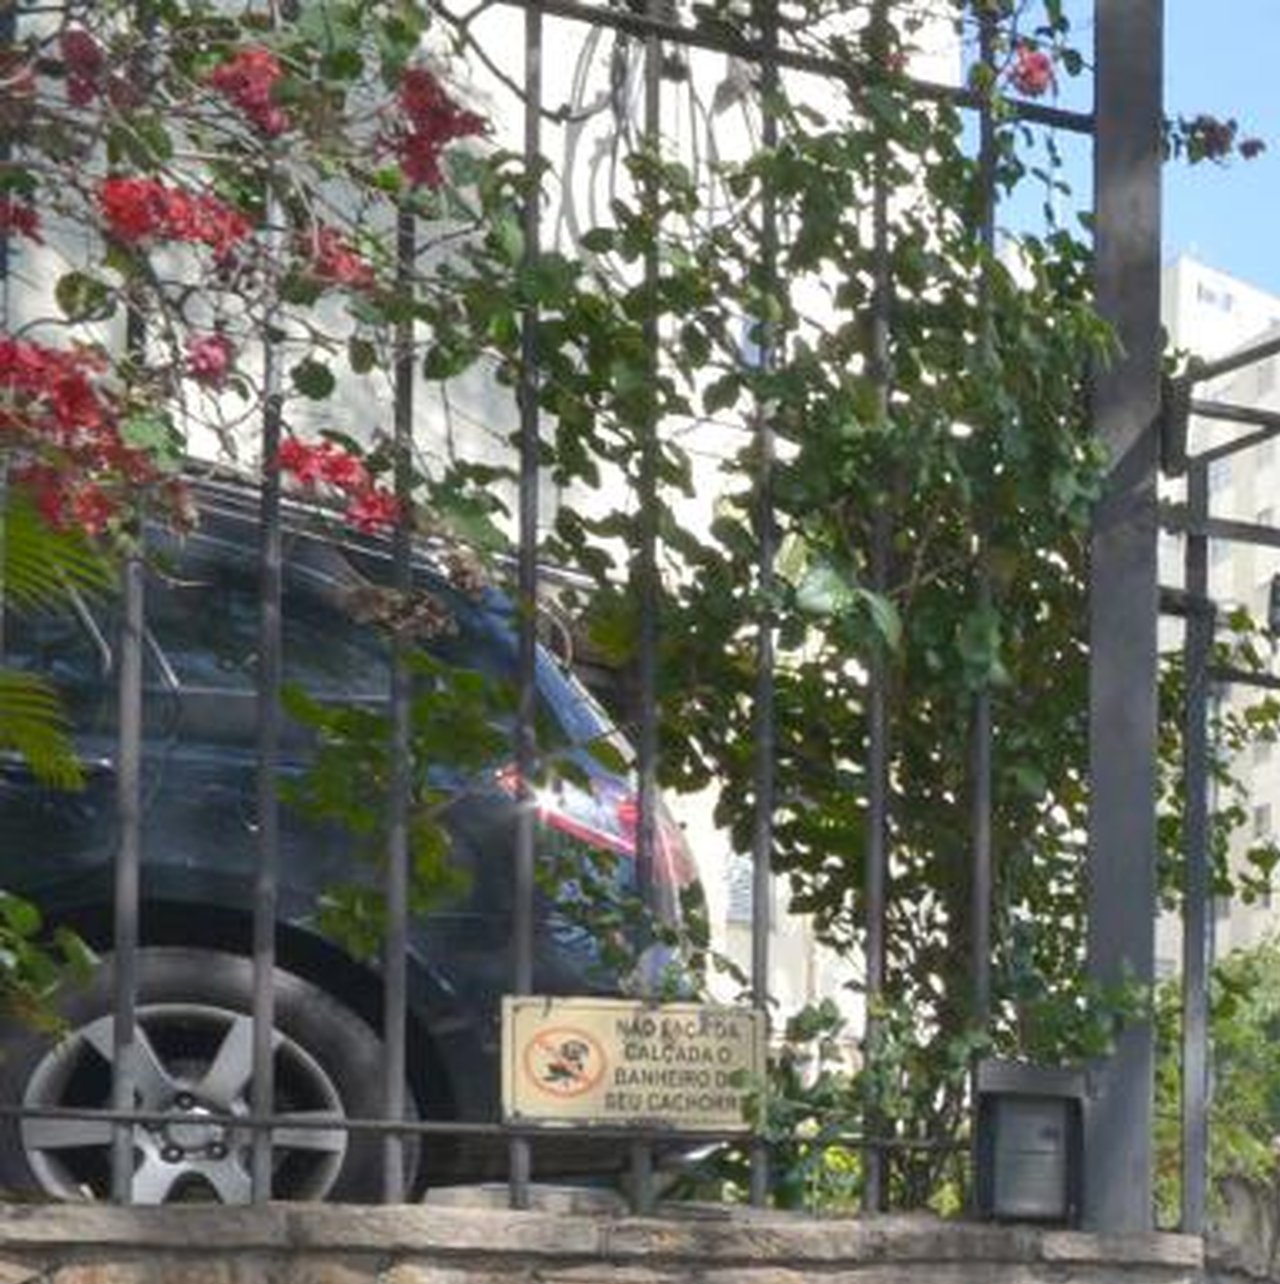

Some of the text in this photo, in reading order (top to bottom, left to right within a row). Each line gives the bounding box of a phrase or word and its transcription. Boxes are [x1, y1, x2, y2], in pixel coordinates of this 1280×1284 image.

[615, 1016, 657, 1039] NÃO
[624, 1042, 733, 1065] CALÇADA O
[614, 1066, 711, 1088] BANHEIRO
[604, 1091, 740, 1113] SEU CACHORR
